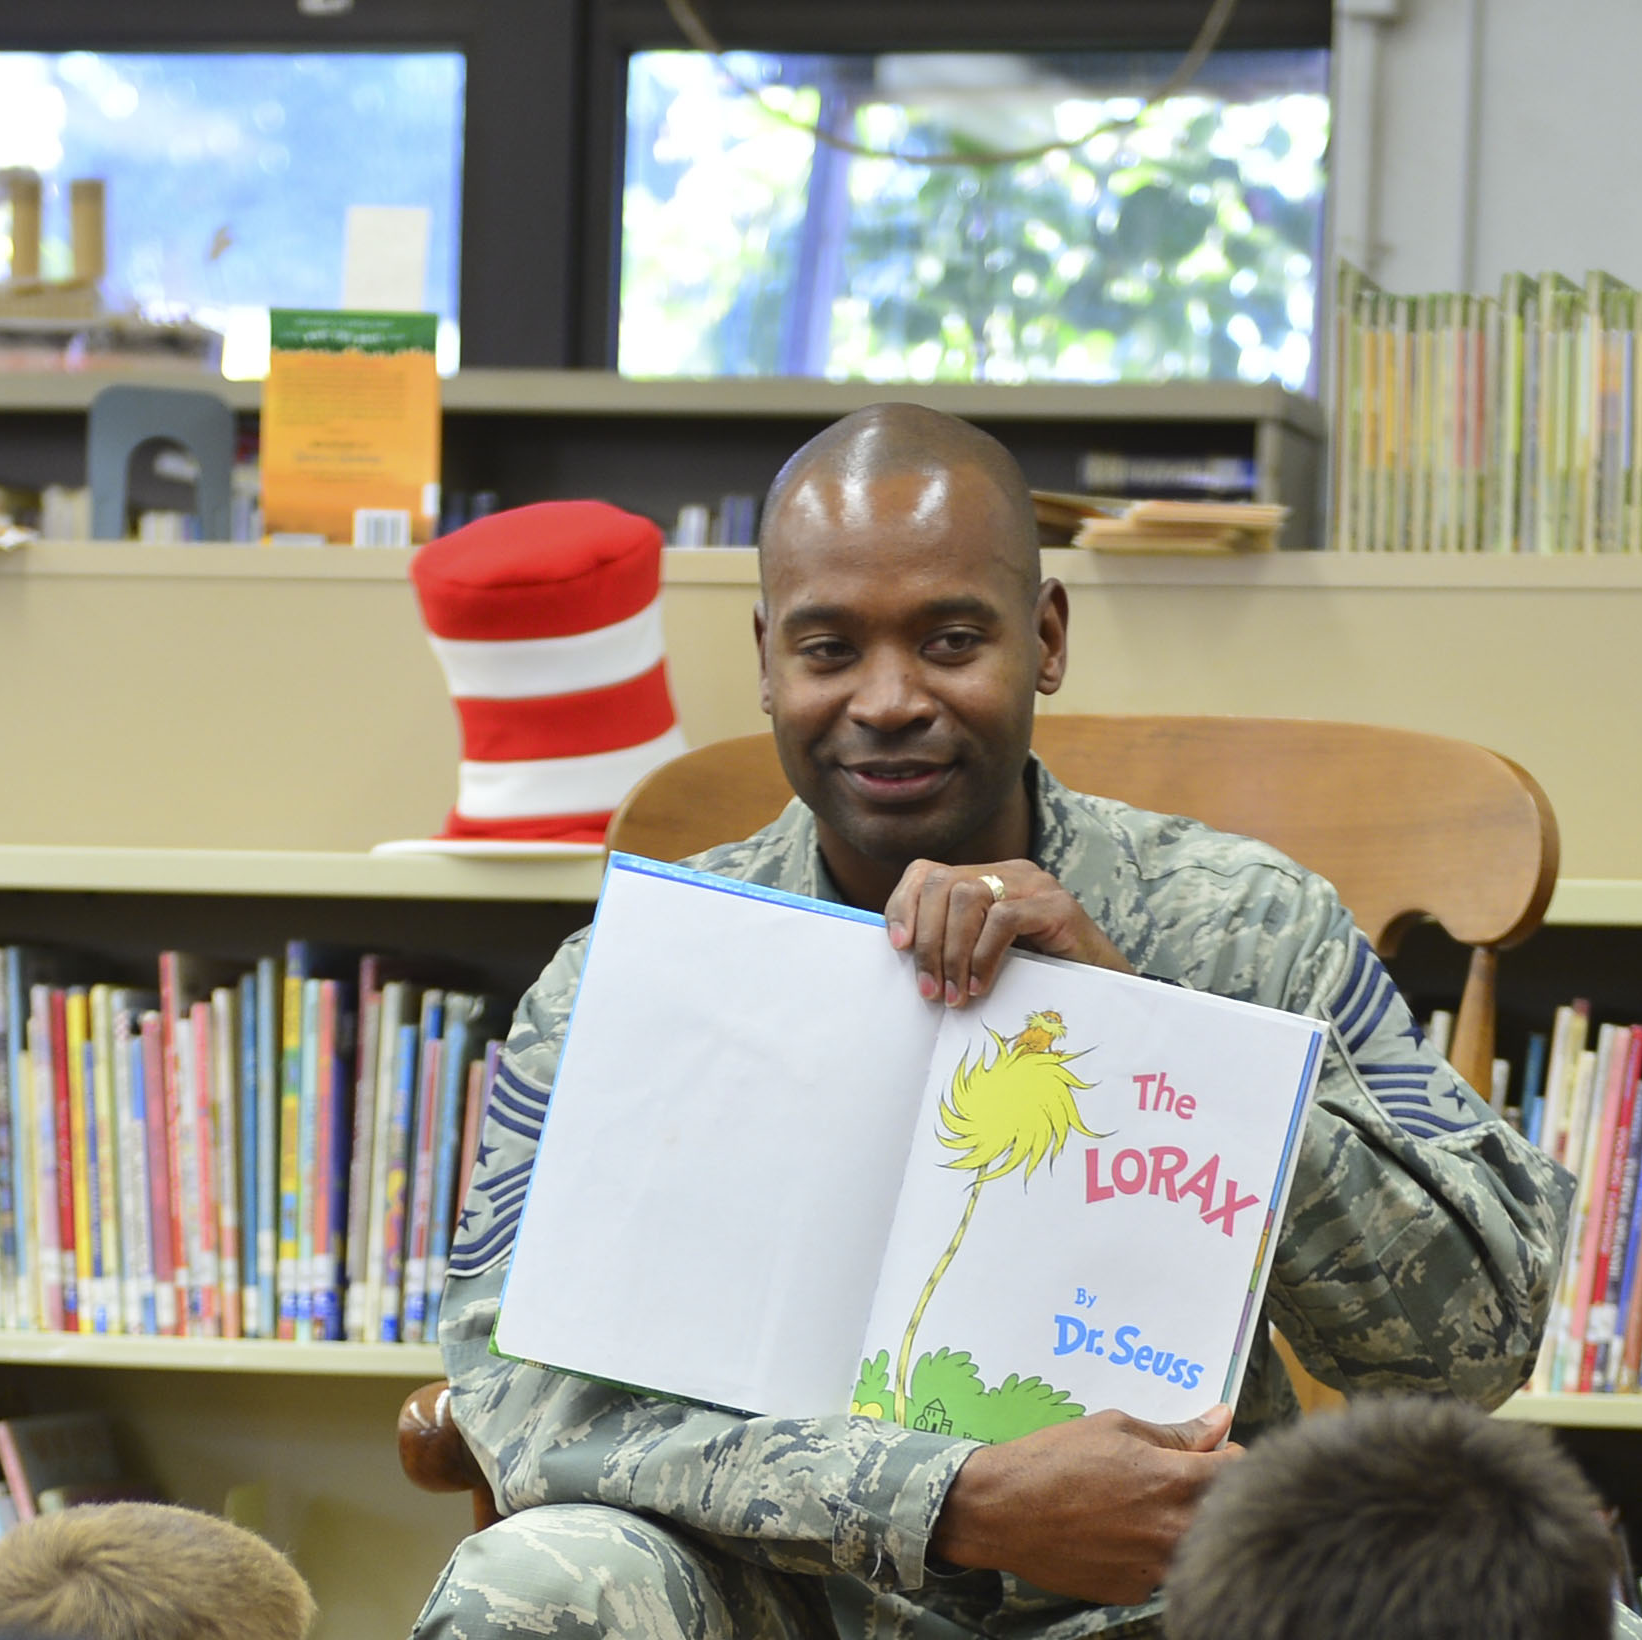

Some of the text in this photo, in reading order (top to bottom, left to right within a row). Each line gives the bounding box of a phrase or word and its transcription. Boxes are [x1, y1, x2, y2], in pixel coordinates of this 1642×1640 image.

[1133, 1072, 1197, 1120] The
[1085, 1145, 1260, 1238] LORAX
[1075, 1287, 1098, 1308] By
[1053, 1314, 1205, 1390] Dr. Seuss
